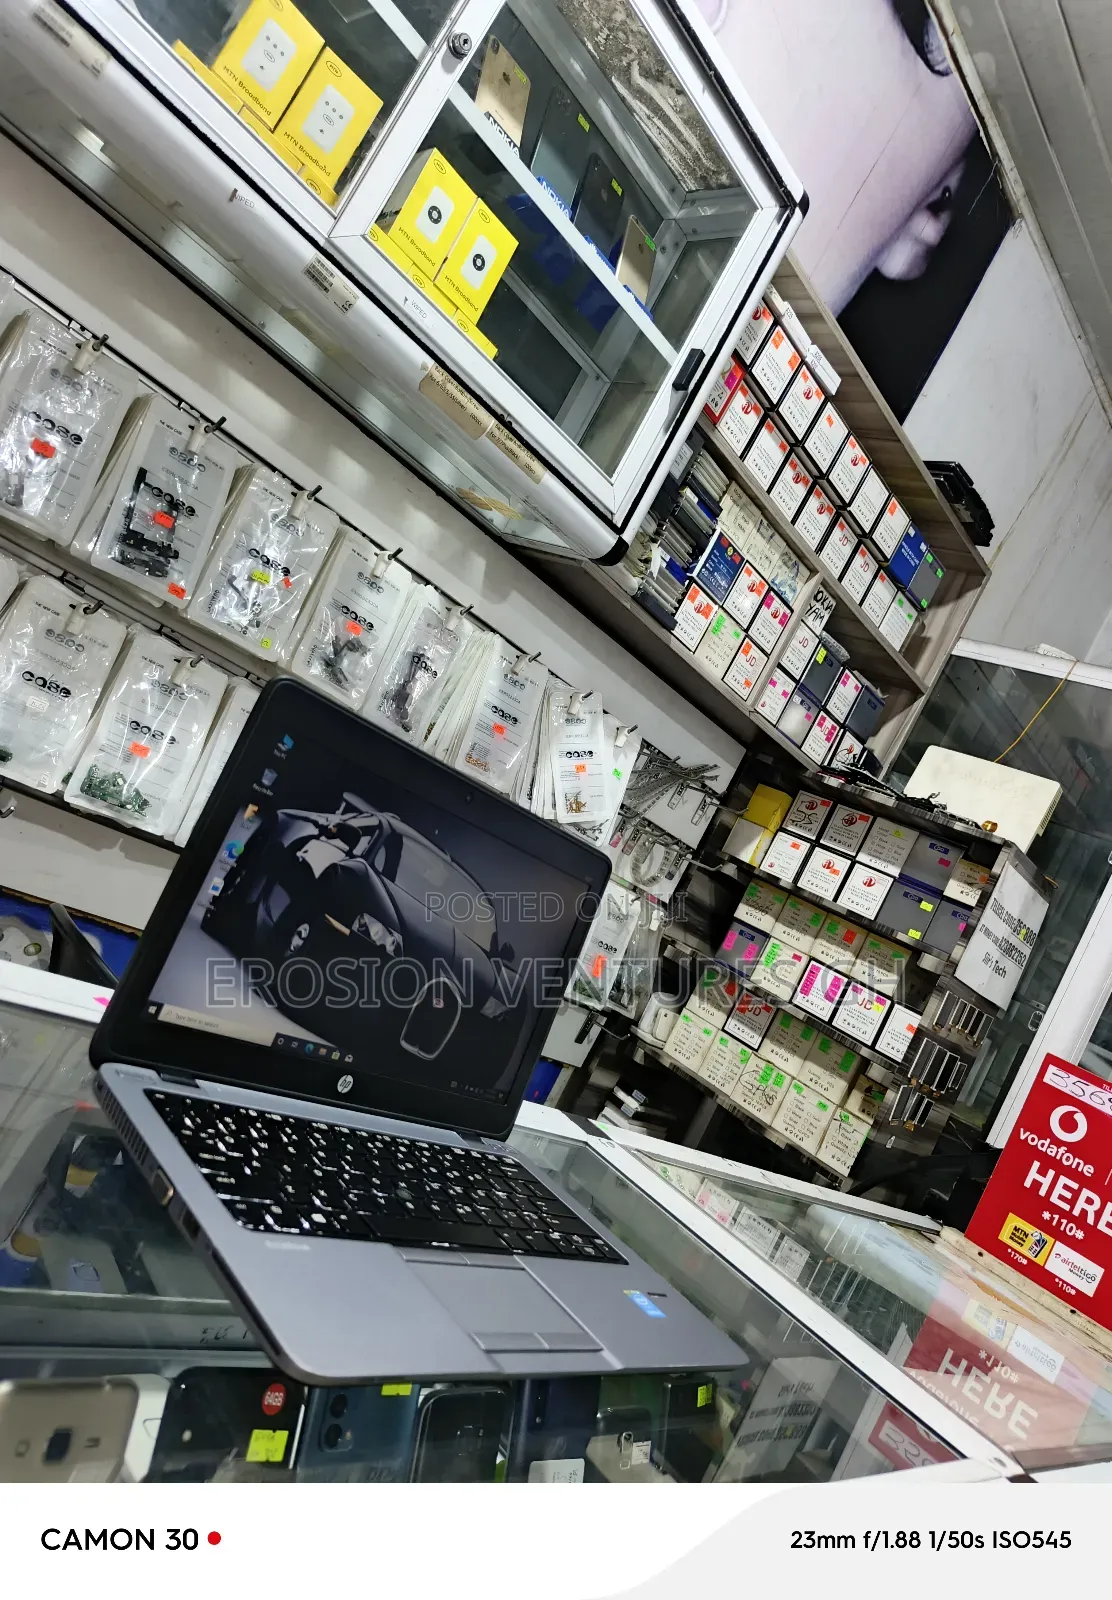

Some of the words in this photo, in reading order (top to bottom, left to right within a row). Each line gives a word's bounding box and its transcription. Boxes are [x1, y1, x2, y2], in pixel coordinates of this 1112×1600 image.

[223, 65, 238, 83] MTN
[238, 79, 272, 117] Broadband
[489, 117, 520, 157] NOKIA
[283, 131, 299, 148] MTN
[298, 145, 331, 177] Broadband
[398, 226, 412, 241] MTN
[410, 239, 436, 267] Broadband
[444, 275, 458, 291] MTN
[455, 286, 479, 311] Broadband
[28, 411, 83, 446] case
[152, 487, 196, 517] case
[839, 534, 850, 547] JD
[249, 548, 290, 577] case
[860, 560, 870, 573] JD
[341, 605, 374, 631] case
[804, 603, 825, 627] YAM
[799, 635, 809, 648] JD
[745, 654, 757, 667] JD
[22, 671, 72, 699] case
[491, 705, 518, 725] case
[130, 721, 176, 745] case
[565, 751, 594, 759] case
[992, 959, 1007, 979] Tech
[747, 1002, 762, 1017] JD
[857, 997, 873, 1011] JD
[837, 1139, 849, 1149] White
[1019, 1127, 1095, 1178] vodafone
[1023, 1159, 1112, 1239] HERE
[1008, 1235, 1025, 1249] Money
[1010, 1231, 1026, 1243] Mobile
[1012, 1225, 1029, 1239] MTN
[1067, 1267, 1085, 1281] Money
[264, 1391, 284, 1407] 64GB
